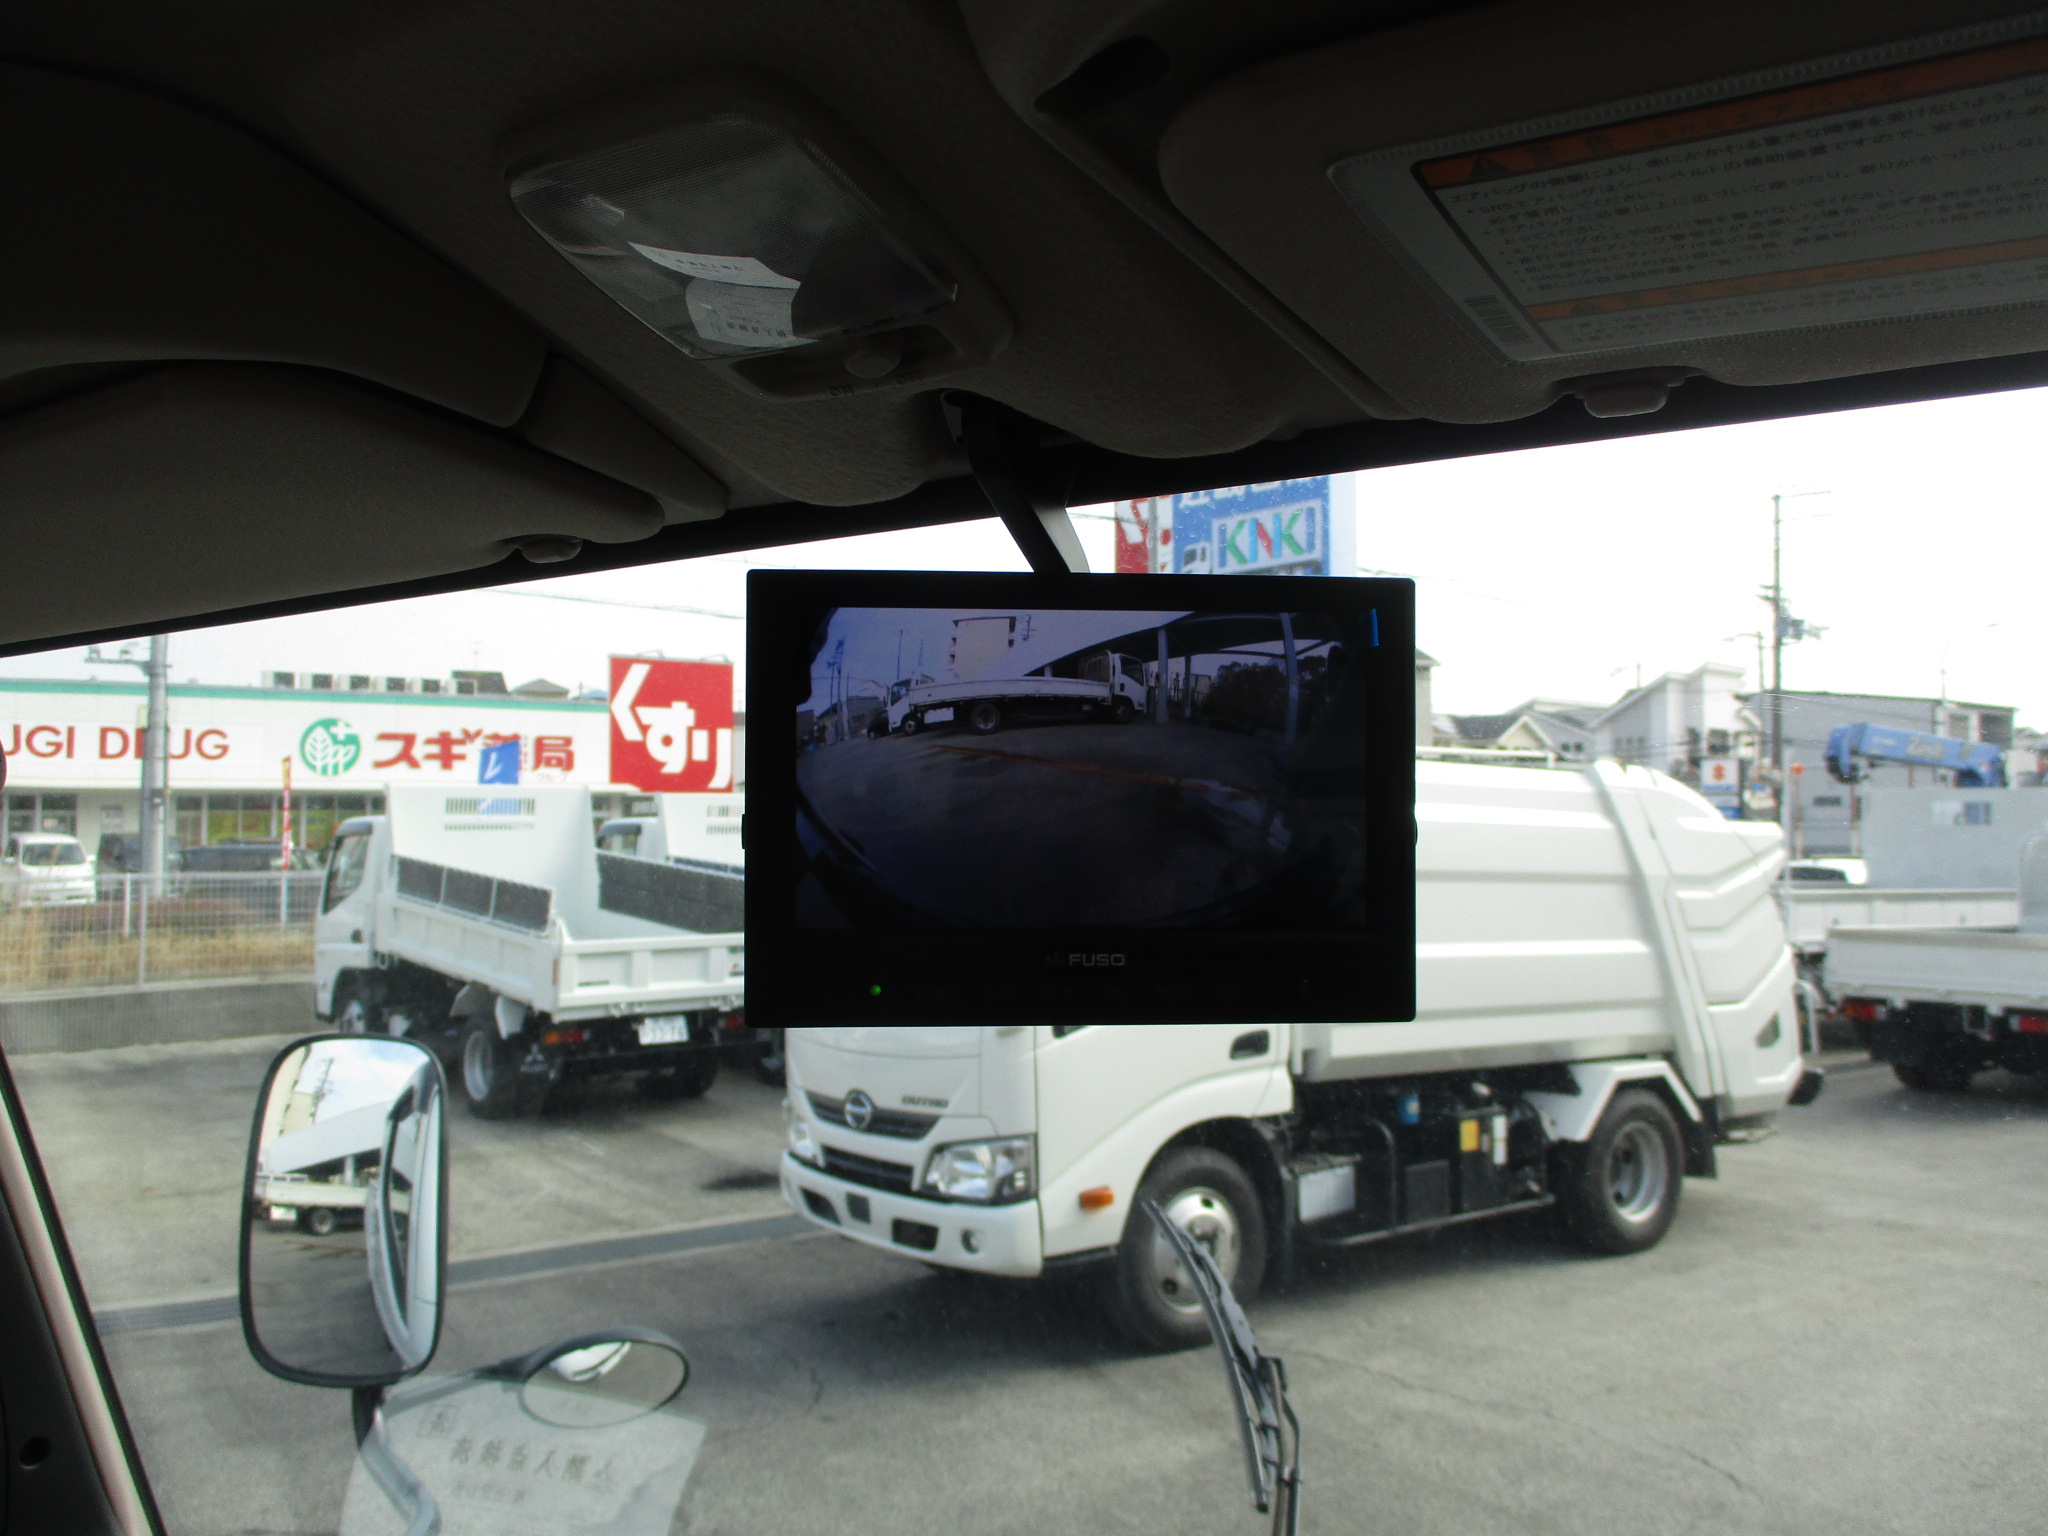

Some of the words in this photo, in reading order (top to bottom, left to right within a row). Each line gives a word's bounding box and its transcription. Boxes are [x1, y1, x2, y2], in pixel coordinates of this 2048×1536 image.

[99, 726, 230, 760] DUG
[610, 663, 732, 789] くすり
[1068, 953, 1126, 966] FUSO
